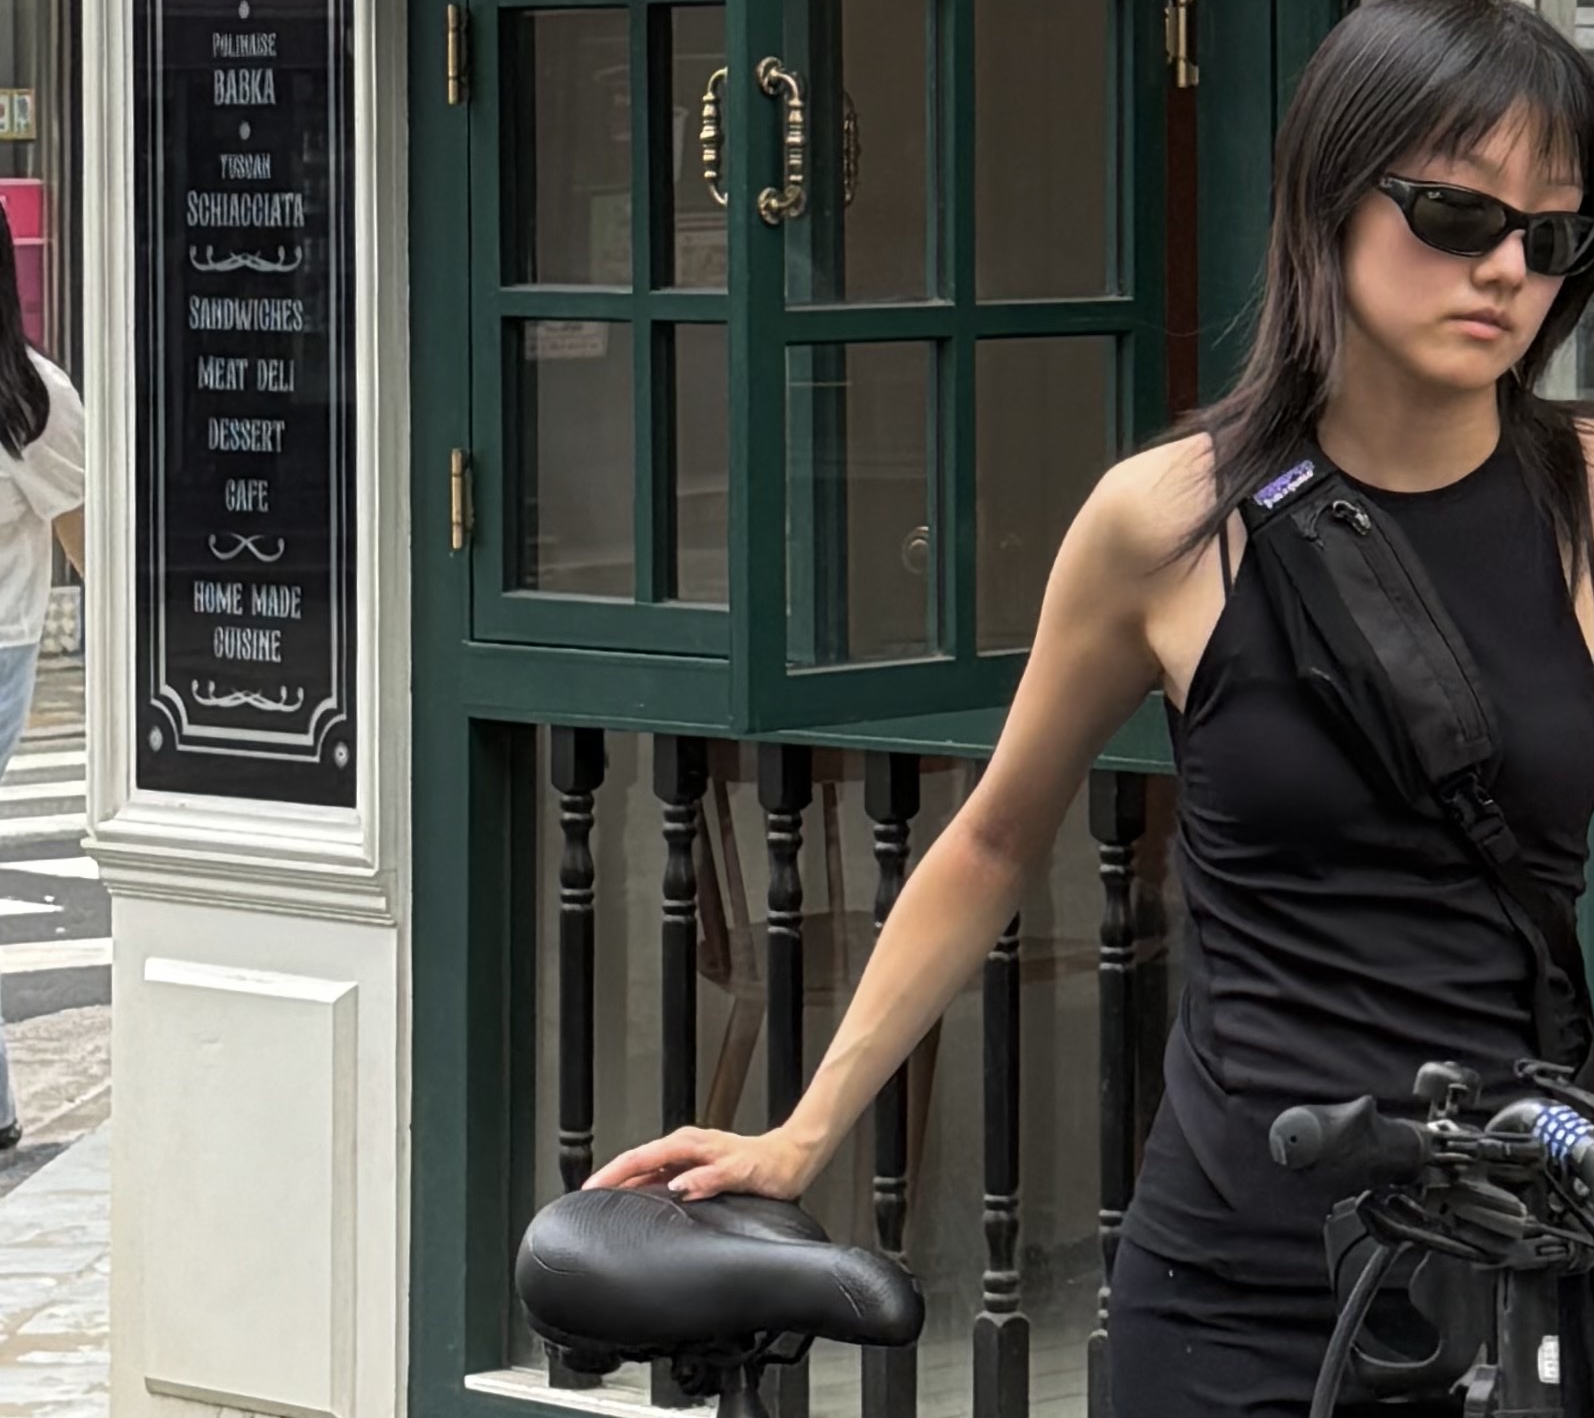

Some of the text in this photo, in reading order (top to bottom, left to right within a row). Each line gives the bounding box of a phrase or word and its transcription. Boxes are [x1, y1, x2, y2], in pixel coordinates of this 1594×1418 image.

[214, 68, 276, 105] BABKA
[220, 153, 271, 179] TUSCAN
[186, 190, 305, 227] SCHIACCIATA
[189, 295, 304, 332] SANDWICHES
[198, 356, 295, 392] MEAT DELI
[208, 418, 285, 452] DESSERT
[225, 479, 268, 512] CAFE
[194, 582, 301, 619] HOME MADE
[213, 626, 282, 663] CUISINE
